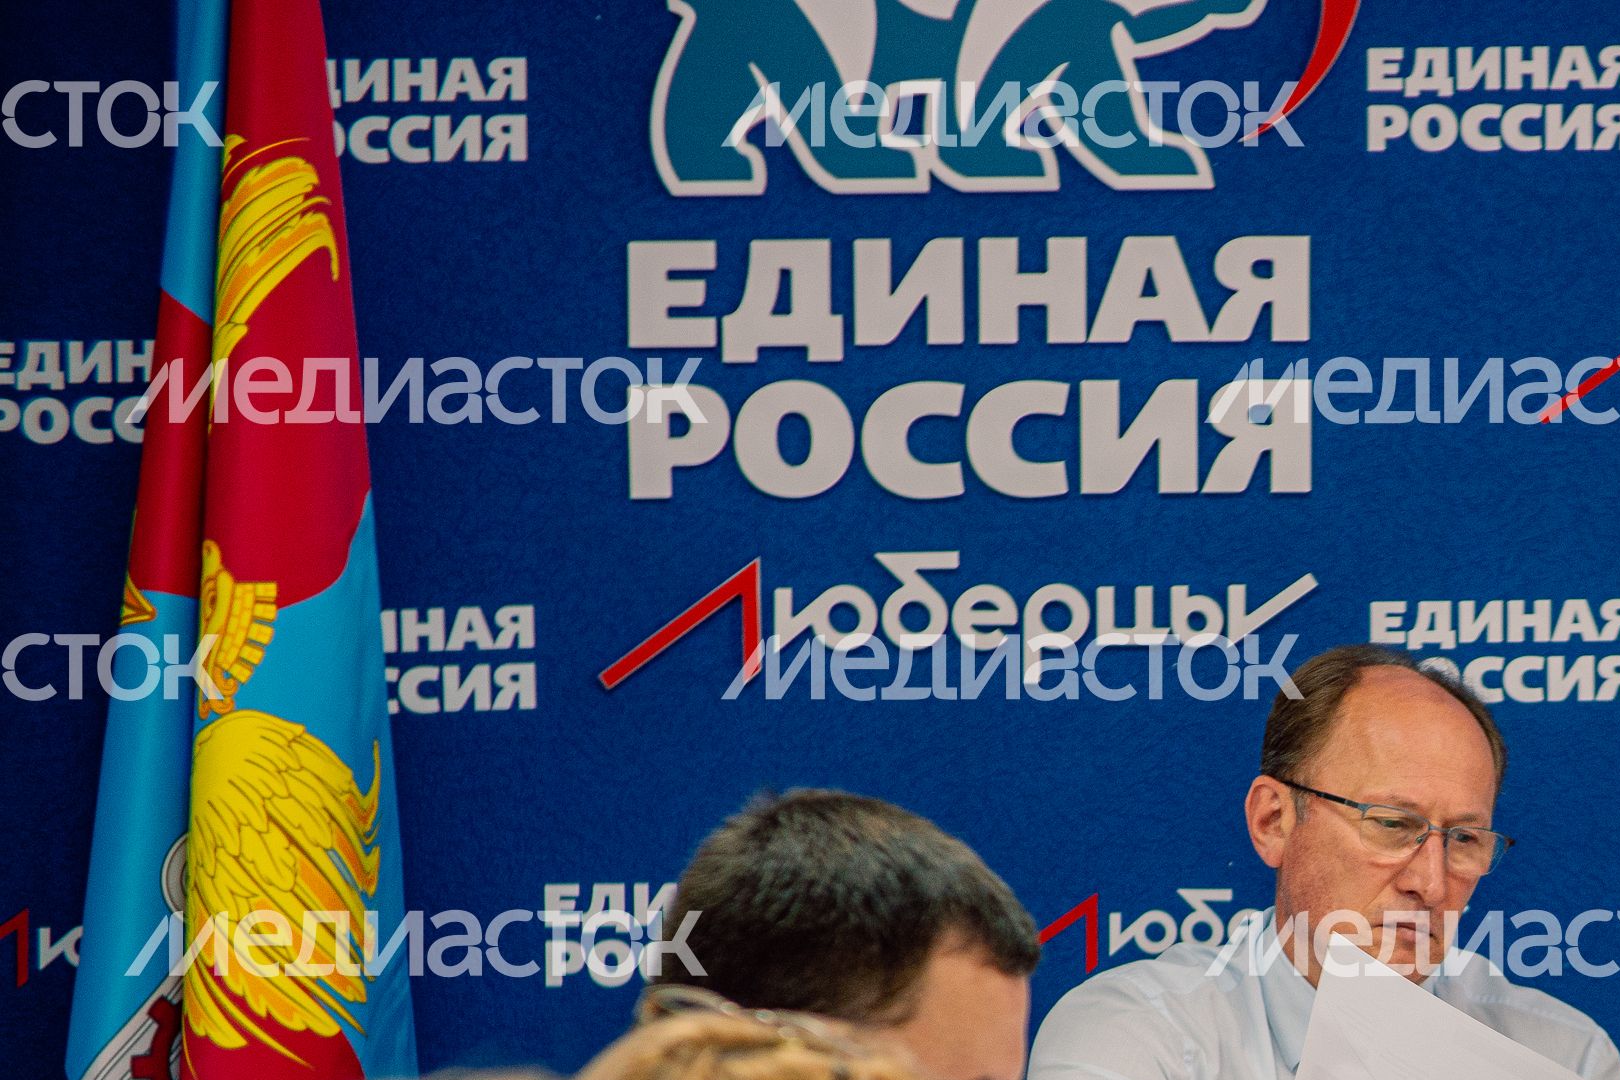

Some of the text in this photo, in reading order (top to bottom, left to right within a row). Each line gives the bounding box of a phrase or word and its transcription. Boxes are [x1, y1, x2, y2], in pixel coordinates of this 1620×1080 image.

[333, 113, 528, 164] ССИЯ
[627, 235, 1312, 364] ЕДИНАЯ
[627, 378, 1313, 500] РОССИЯ
[598, 550, 1319, 690] Люберцы
